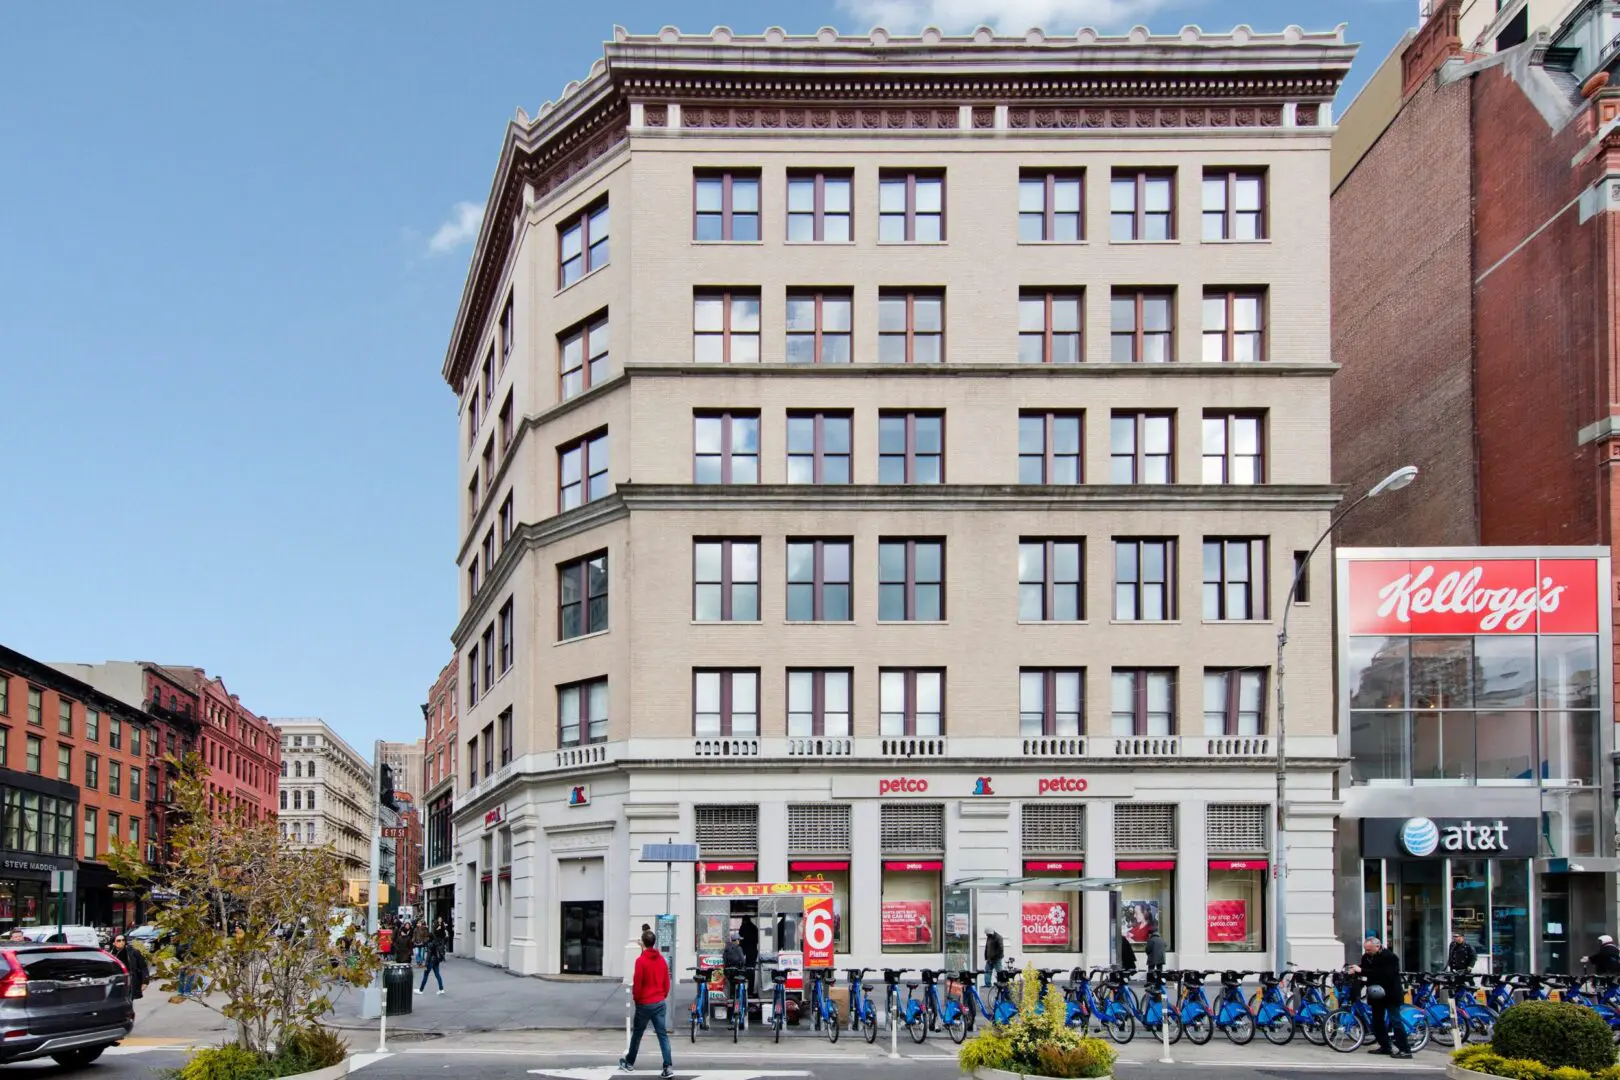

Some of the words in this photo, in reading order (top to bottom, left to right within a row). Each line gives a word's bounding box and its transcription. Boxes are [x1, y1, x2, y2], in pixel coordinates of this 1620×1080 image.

[1377, 565, 1565, 631] Kellogg's
[879, 777, 928, 795] petco
[1039, 776, 1088, 795] petco
[1442, 820, 1509, 850] at&t
[4, 860, 28, 869] STEVE
[29, 862, 58, 871] MADDEN
[809, 950, 829, 958] Platter
